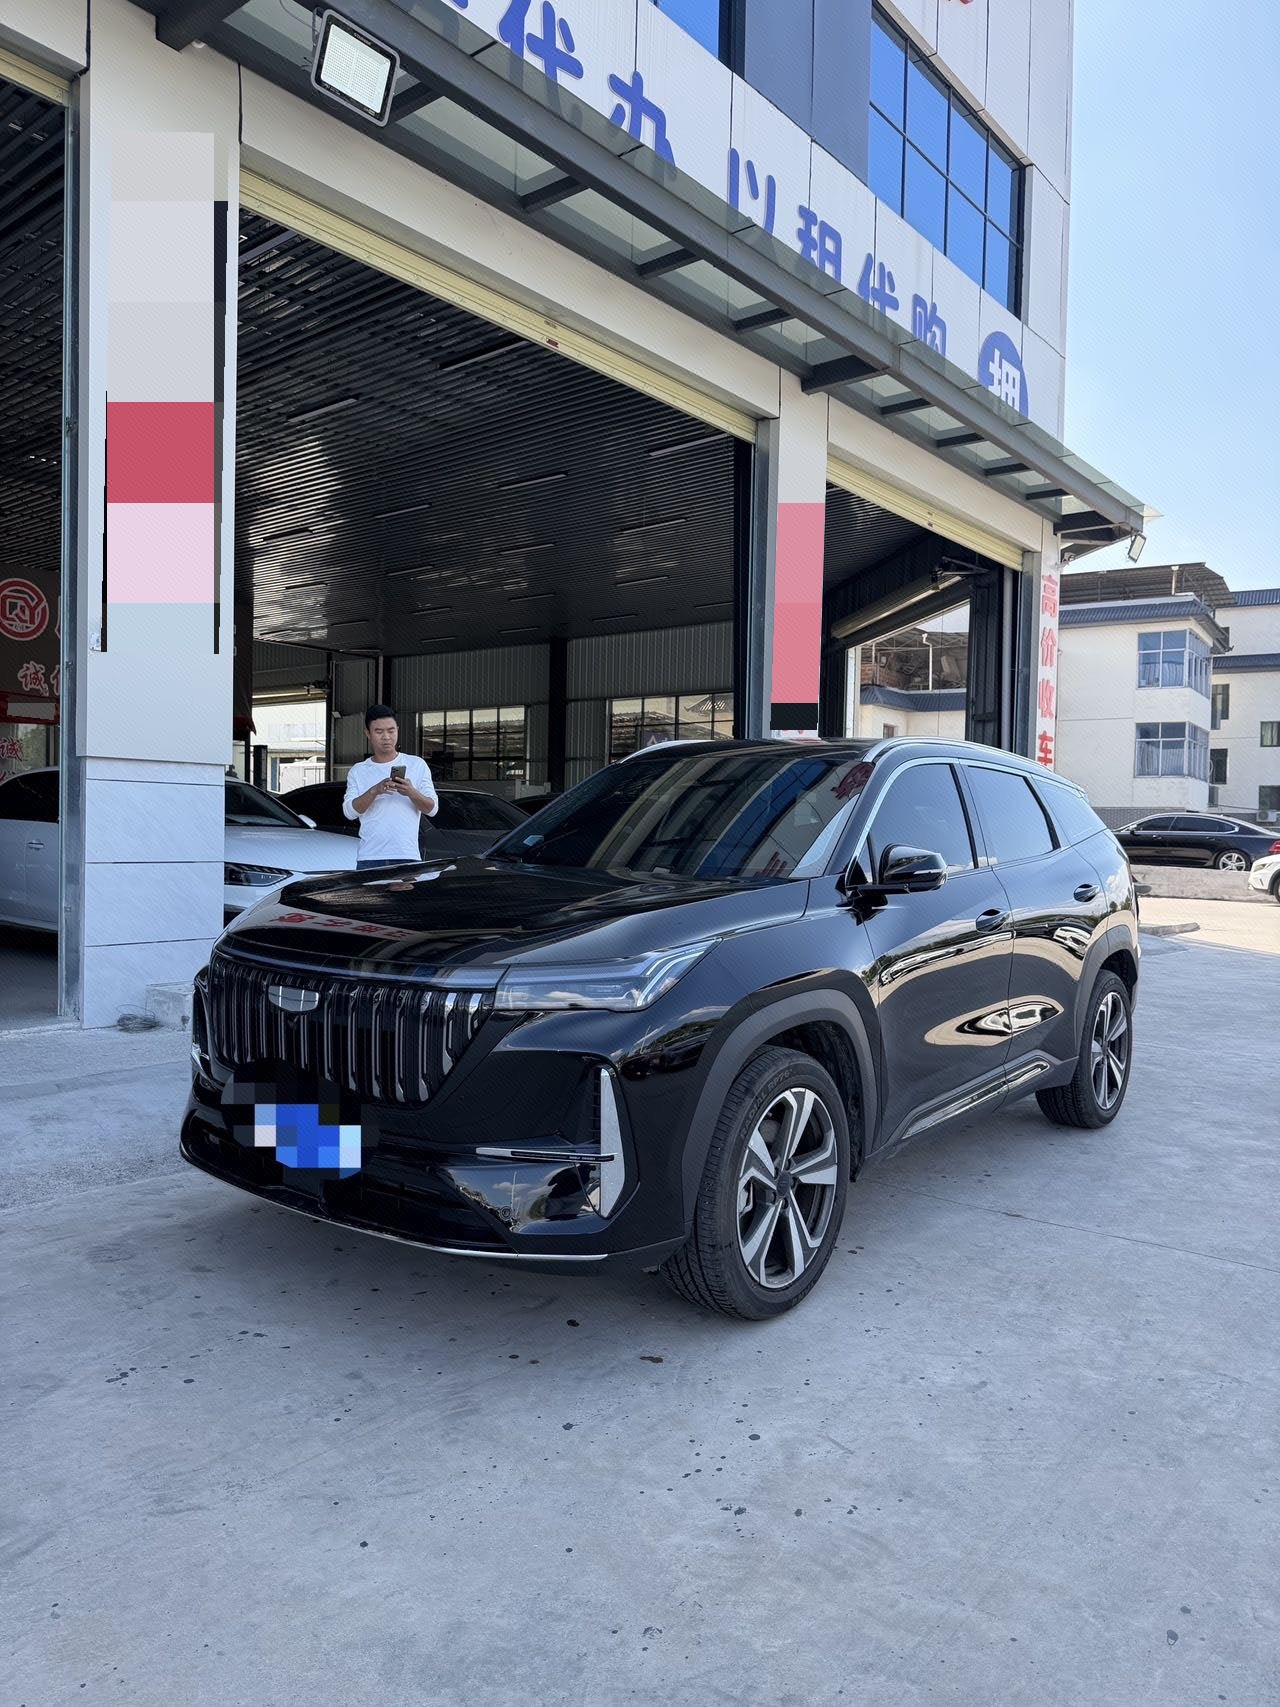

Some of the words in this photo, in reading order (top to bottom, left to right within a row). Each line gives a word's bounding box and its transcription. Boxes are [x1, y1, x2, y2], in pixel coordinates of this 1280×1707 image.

[453, 0, 677, 167] 代办
[18, 660, 61, 698] 诚
[1037, 573, 1058, 767] 高价收车
